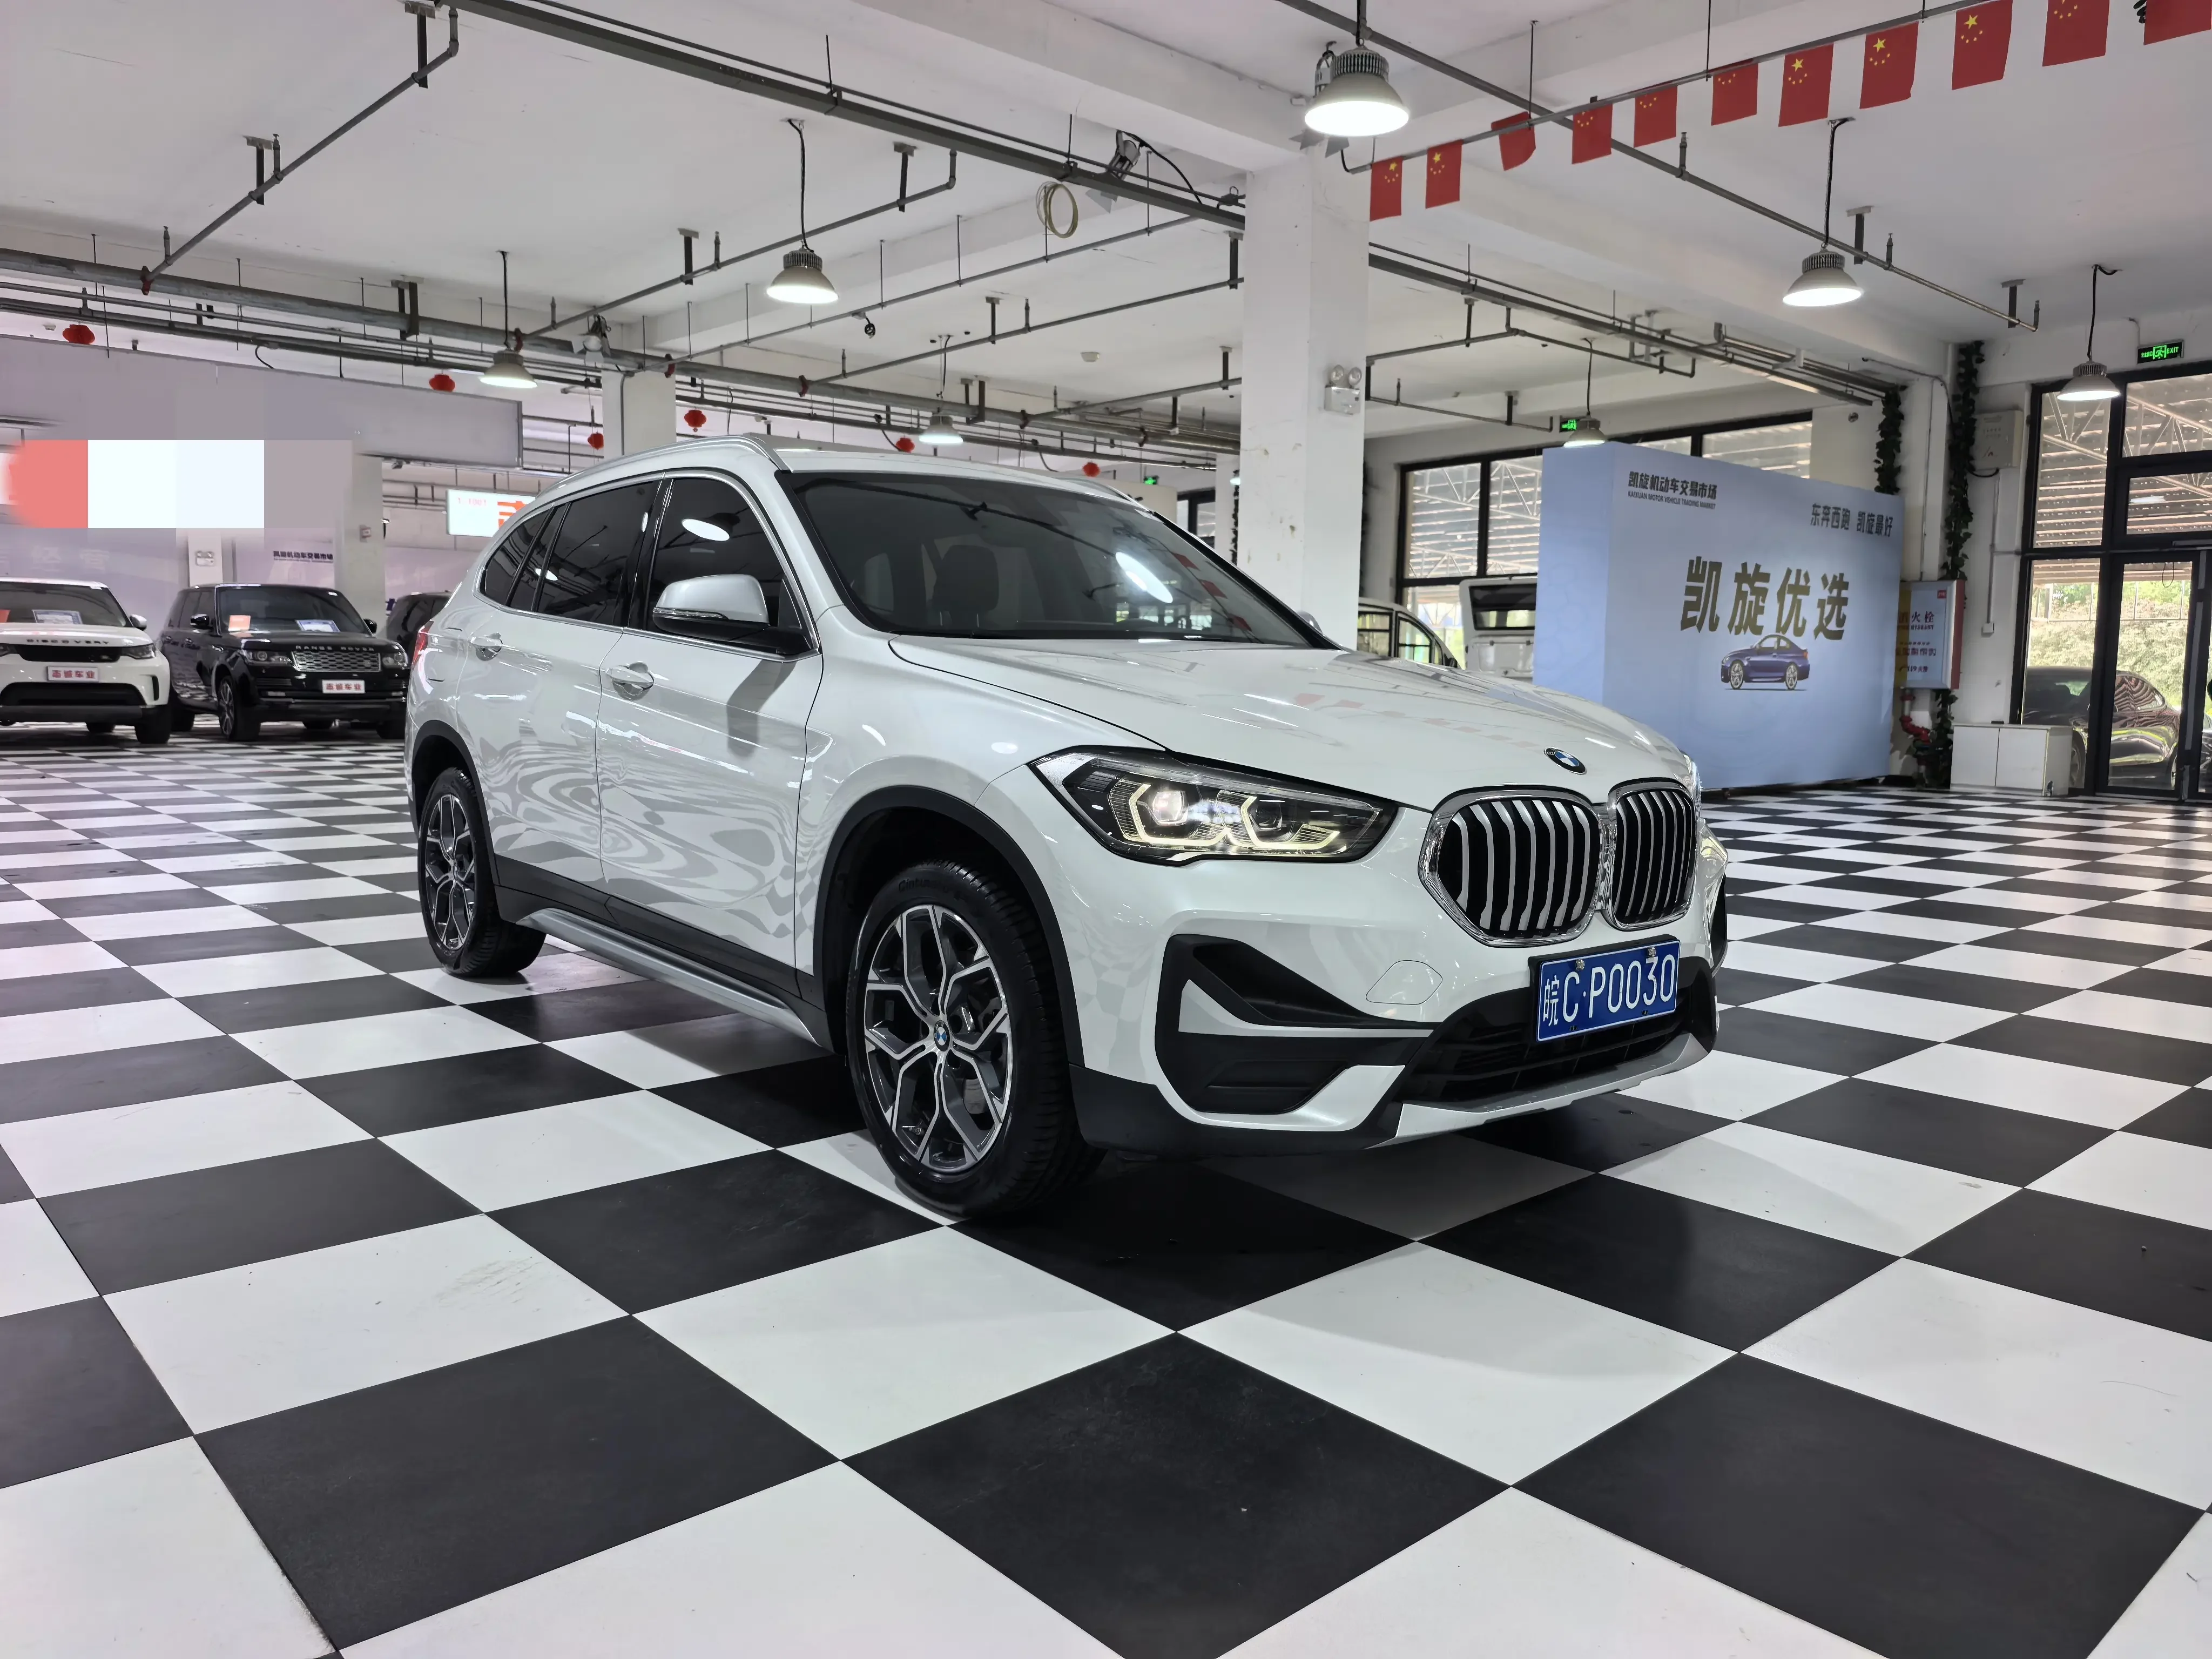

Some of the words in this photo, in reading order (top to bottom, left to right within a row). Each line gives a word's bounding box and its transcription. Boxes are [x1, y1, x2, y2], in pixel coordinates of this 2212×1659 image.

[2167, 346, 2179, 354] EXIT
[1628, 471, 1717, 500] 凯旋机动车交易市场
[1810, 503, 1850, 530] 东奔西跑
[1856, 511, 1893, 538] 凯旋最好
[1680, 556, 1850, 640] 凯旋优选
